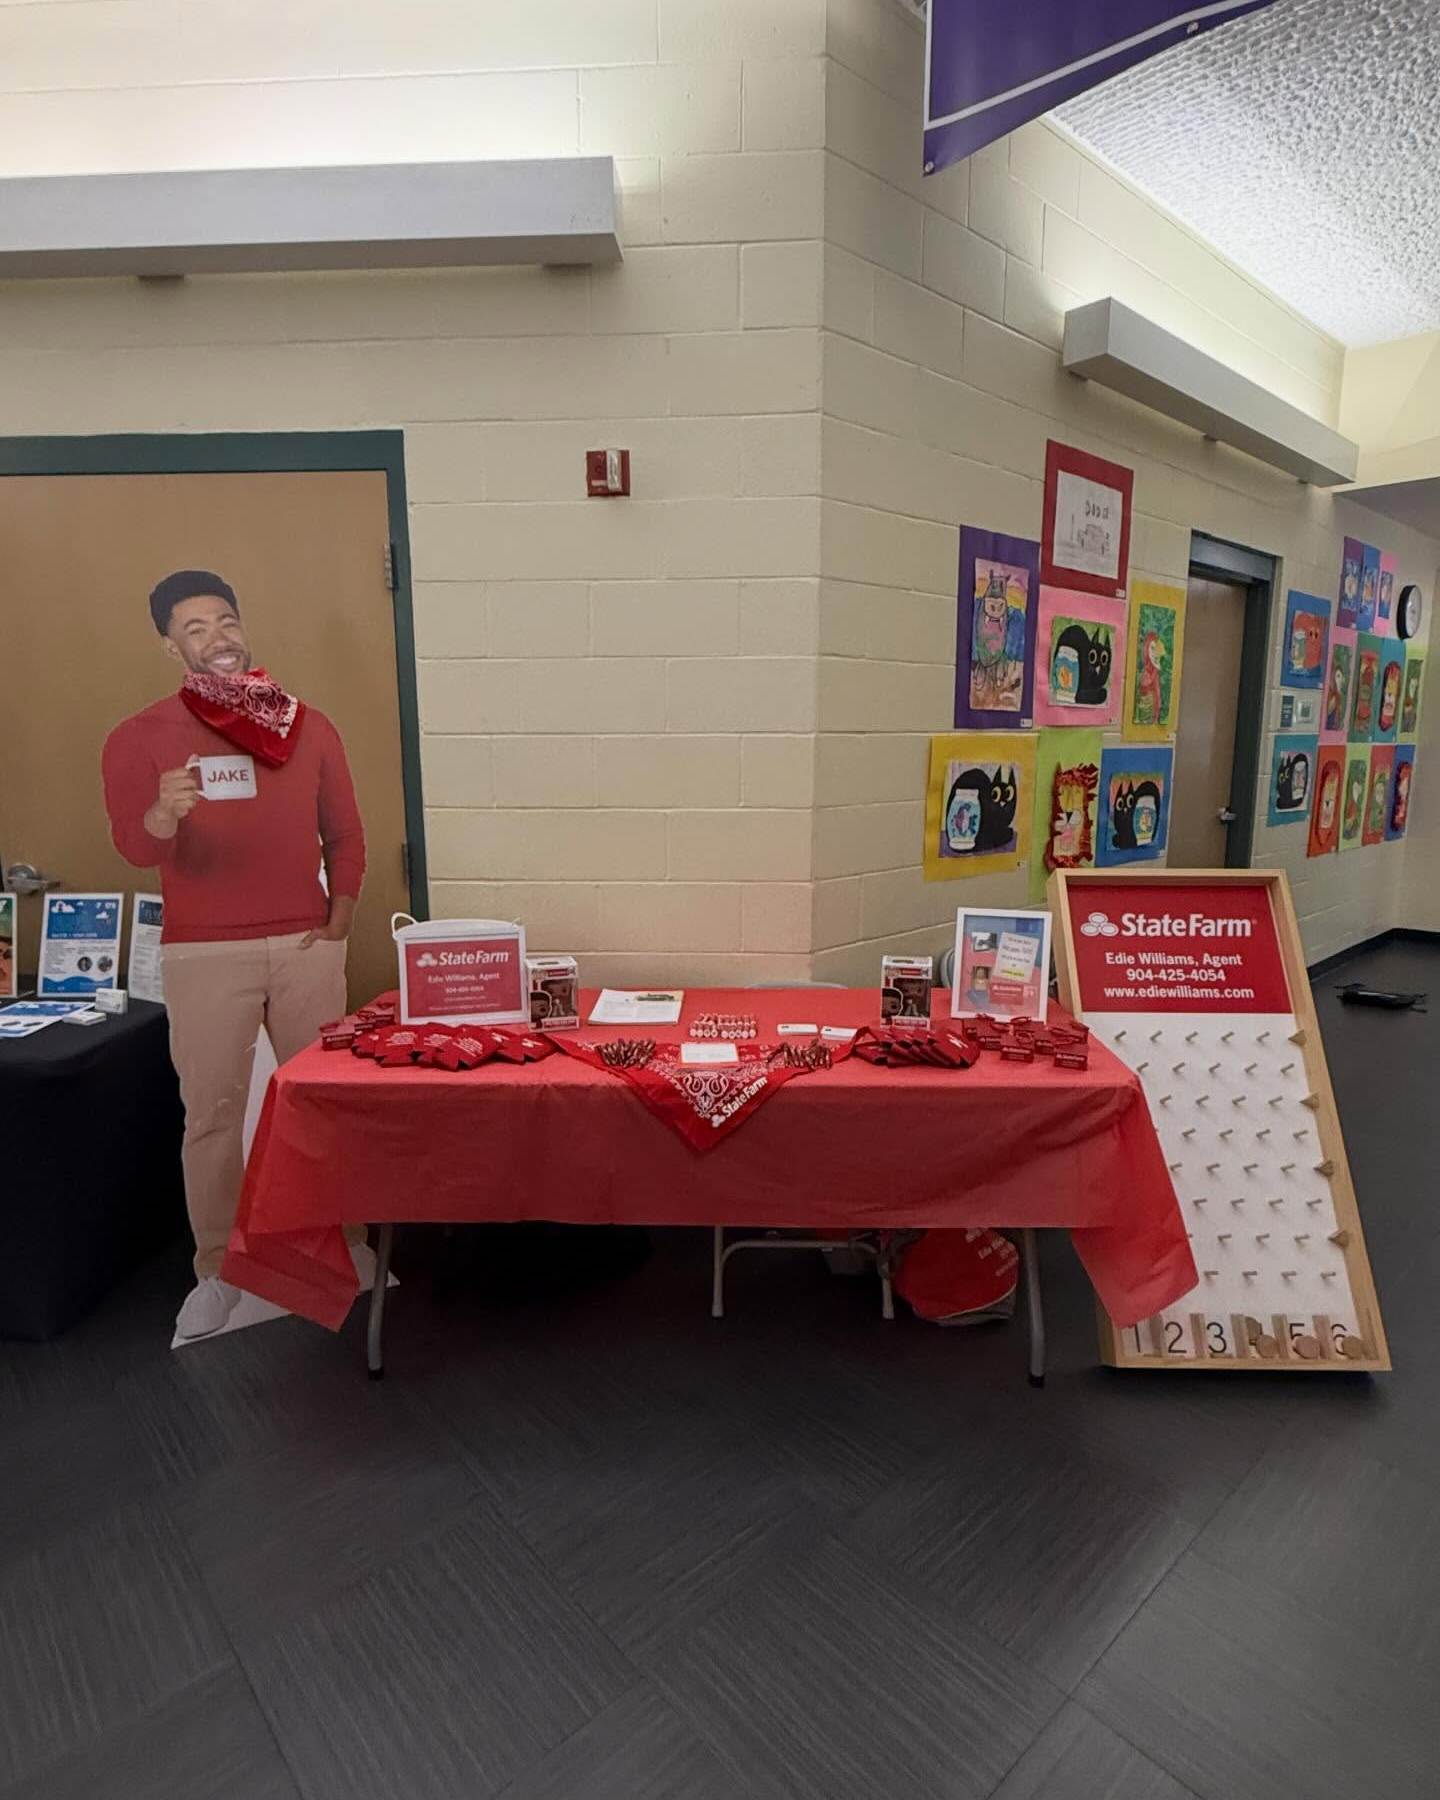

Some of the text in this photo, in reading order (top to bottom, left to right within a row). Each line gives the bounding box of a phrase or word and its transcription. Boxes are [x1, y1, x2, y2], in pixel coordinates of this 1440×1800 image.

[207, 769, 249, 783] JAKE
[1105, 952, 1243, 967] Edie Williams, Agent
[1126, 968, 1226, 982] 904-425-4054
[1104, 985, 1255, 999] www.ediewilliams.com
[1164, 1321, 1188, 1354] 2
[1206, 1321, 1227, 1354] 3
[1289, 1322, 1307, 1355] 5
